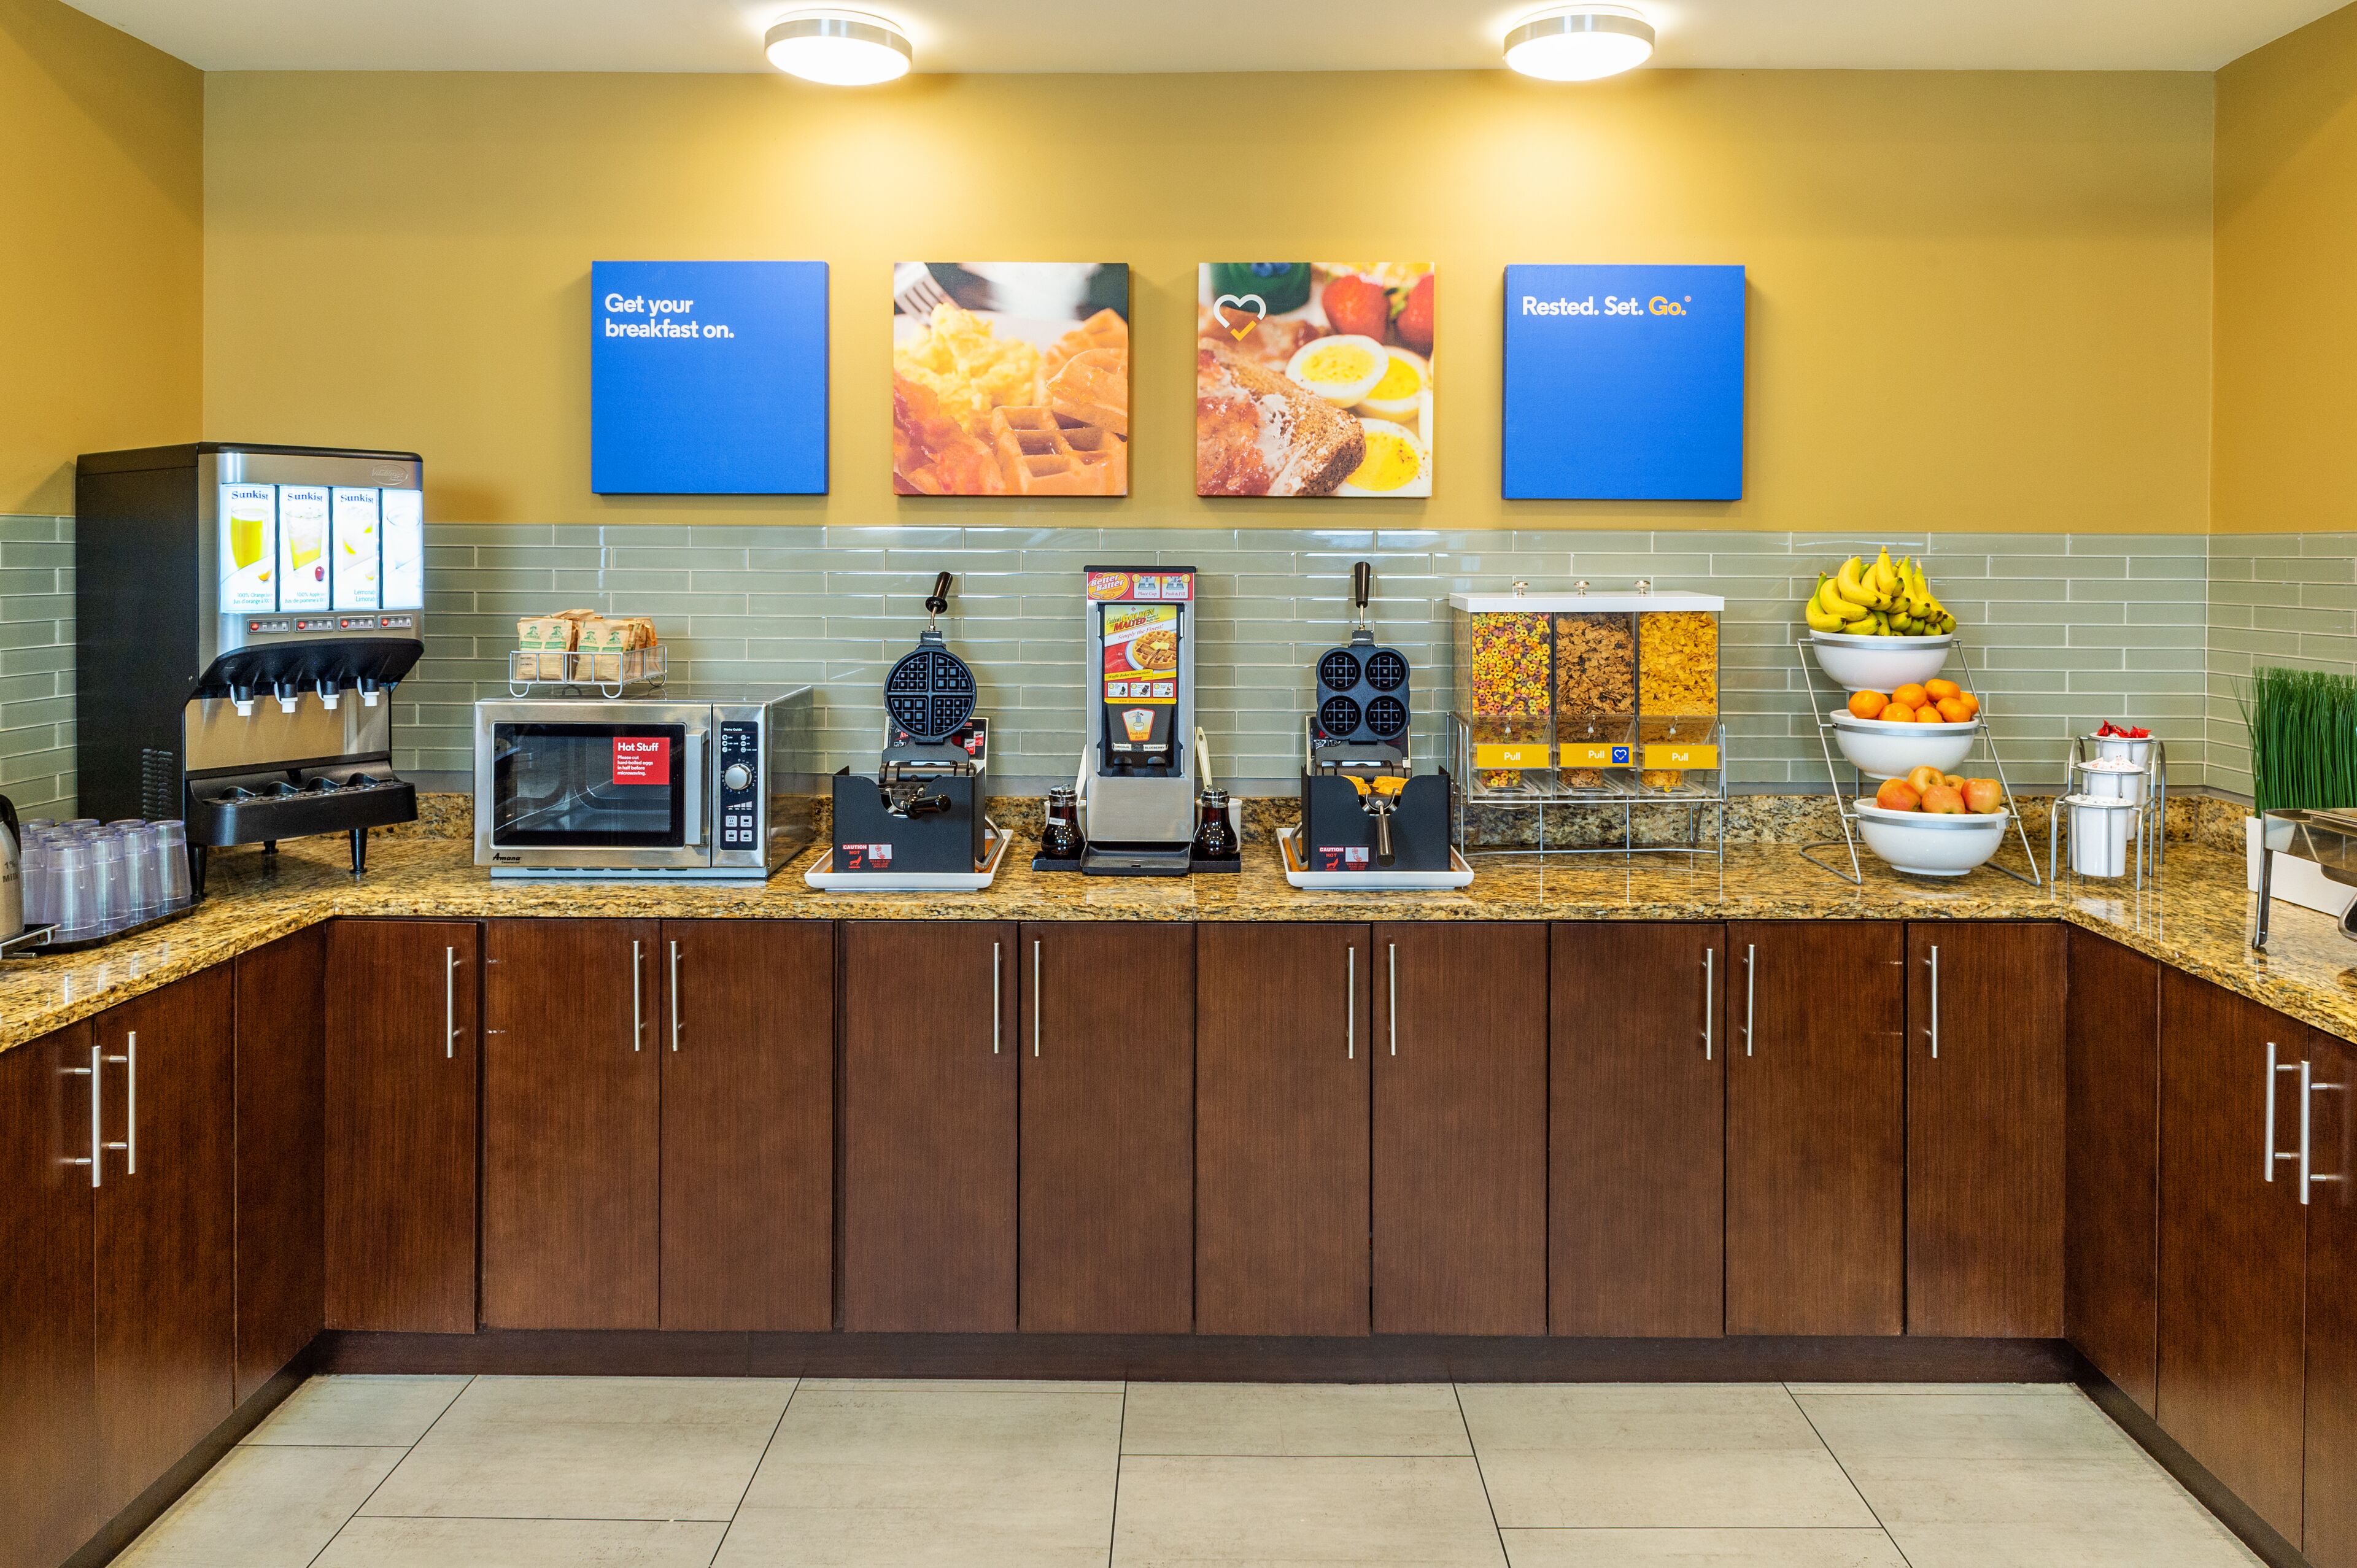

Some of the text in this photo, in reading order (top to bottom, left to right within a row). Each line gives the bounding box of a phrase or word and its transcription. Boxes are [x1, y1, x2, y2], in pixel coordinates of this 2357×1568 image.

[605, 293, 694, 317] Get your
[1522, 296, 1599, 315] Rested.
[1604, 295, 1644, 315] Set.
[605, 318, 735, 339] breakfast on.
[231, 490, 268, 501] Sunkist
[287, 492, 323, 502] Sunkist
[341, 494, 373, 503] Sunkist
[1091, 574, 1120, 587] Better
[1096, 579, 1125, 592] Batter
[1113, 617, 1147, 631] MALTED
[1118, 631, 1136, 639] Simply
[1146, 624, 1164, 633] Finest!
[617, 742, 659, 751] Hot Stuff
[1504, 752, 1520, 760] Pull
[1588, 750, 1604, 759] Pull
[1672, 752, 1689, 762] Pull
